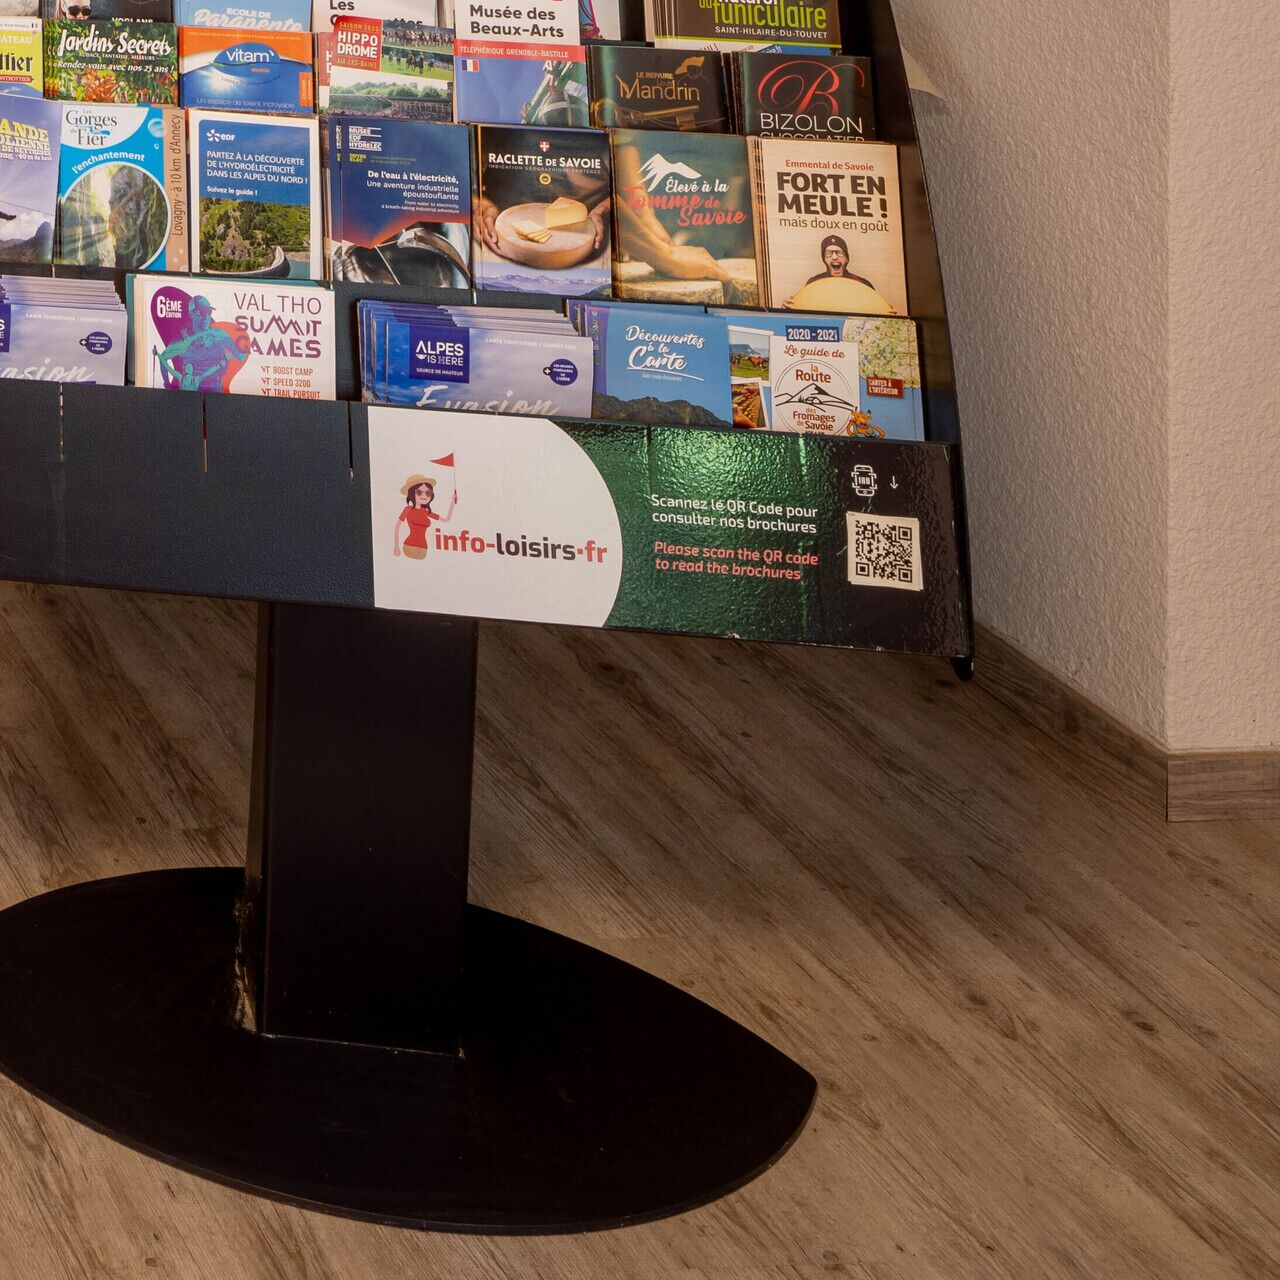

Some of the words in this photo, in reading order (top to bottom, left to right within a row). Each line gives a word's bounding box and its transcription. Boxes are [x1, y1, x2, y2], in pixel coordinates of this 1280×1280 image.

[470, 4, 522, 20] Musée
[527, 7, 556, 20] des
[470, 22, 564, 37] Beaux-Arts
[715, 25, 827, 39] SAINT-HILAIRE-DU-TOUVET
[58, 24, 113, 57] Jardins
[115, 31, 173, 56] Secrets
[338, 31, 378, 45] HIPPO
[337, 44, 377, 58] DROME
[460, 45, 504, 55] TÉLÉPHÉRIQUE
[506, 48, 568, 58] GRENOBLE-BASTILLE
[616, 75, 700, 100] Mandrin
[66, 110, 117, 130] Gorges
[760, 112, 862, 133] BIZOLON
[78, 128, 107, 146] Fier
[349, 141, 382, 151] HYDRELEC
[71, 151, 145, 174] l'enchantement
[207, 151, 233, 159] PARTEZ
[244, 153, 252, 161] LA
[255, 153, 304, 166] DÉCOUVERTE
[489, 153, 543, 165] RACLETTE
[545, 158, 557, 166] DE
[559, 157, 601, 168] SAVOIE
[218, 160, 295, 174] L'HYDROÉLECTRICITÉ
[236, 187, 253, 196] guide
[665, 177, 700, 193] Élevé
[703, 181, 712, 192] à
[715, 179, 729, 192] la
[777, 172, 844, 194] FORT
[851, 175, 886, 195] EN
[623, 185, 706, 210] Tomme
[704, 196, 720, 209] de
[677, 204, 747, 227] Savoie
[780, 217, 808, 227] mais
[811, 217, 840, 229] doux
[843, 221, 858, 230] en
[861, 219, 889, 234] goût
[234, 293, 271, 312] VAL
[277, 295, 322, 315] THO
[234, 315, 322, 337] SUMMIT
[788, 328, 811, 340] 2020
[817, 329, 838, 340] 2021
[784, 344, 798, 357] Le
[800, 347, 829, 359] guide
[832, 349, 845, 358] de
[795, 369, 832, 383] Route
[792, 411, 836, 422] Fromages
[651, 495, 707, 511] Scannez
[711, 498, 724, 511] le
[727, 500, 746, 514] QR
[749, 502, 783, 516] Code
[786, 507, 818, 519] pour
[652, 512, 717, 526] consulter
[720, 517, 744, 528] nos
[747, 517, 816, 534] brochures
[654, 541, 699, 556] Please
[702, 548, 733, 559] scan
[736, 547, 759, 561] the
[763, 549, 782, 564] QR
[785, 552, 819, 566] code
[655, 558, 669, 570] to
[672, 560, 702, 573] read
[705, 561, 729, 575] the
[732, 564, 801, 581] brochures
